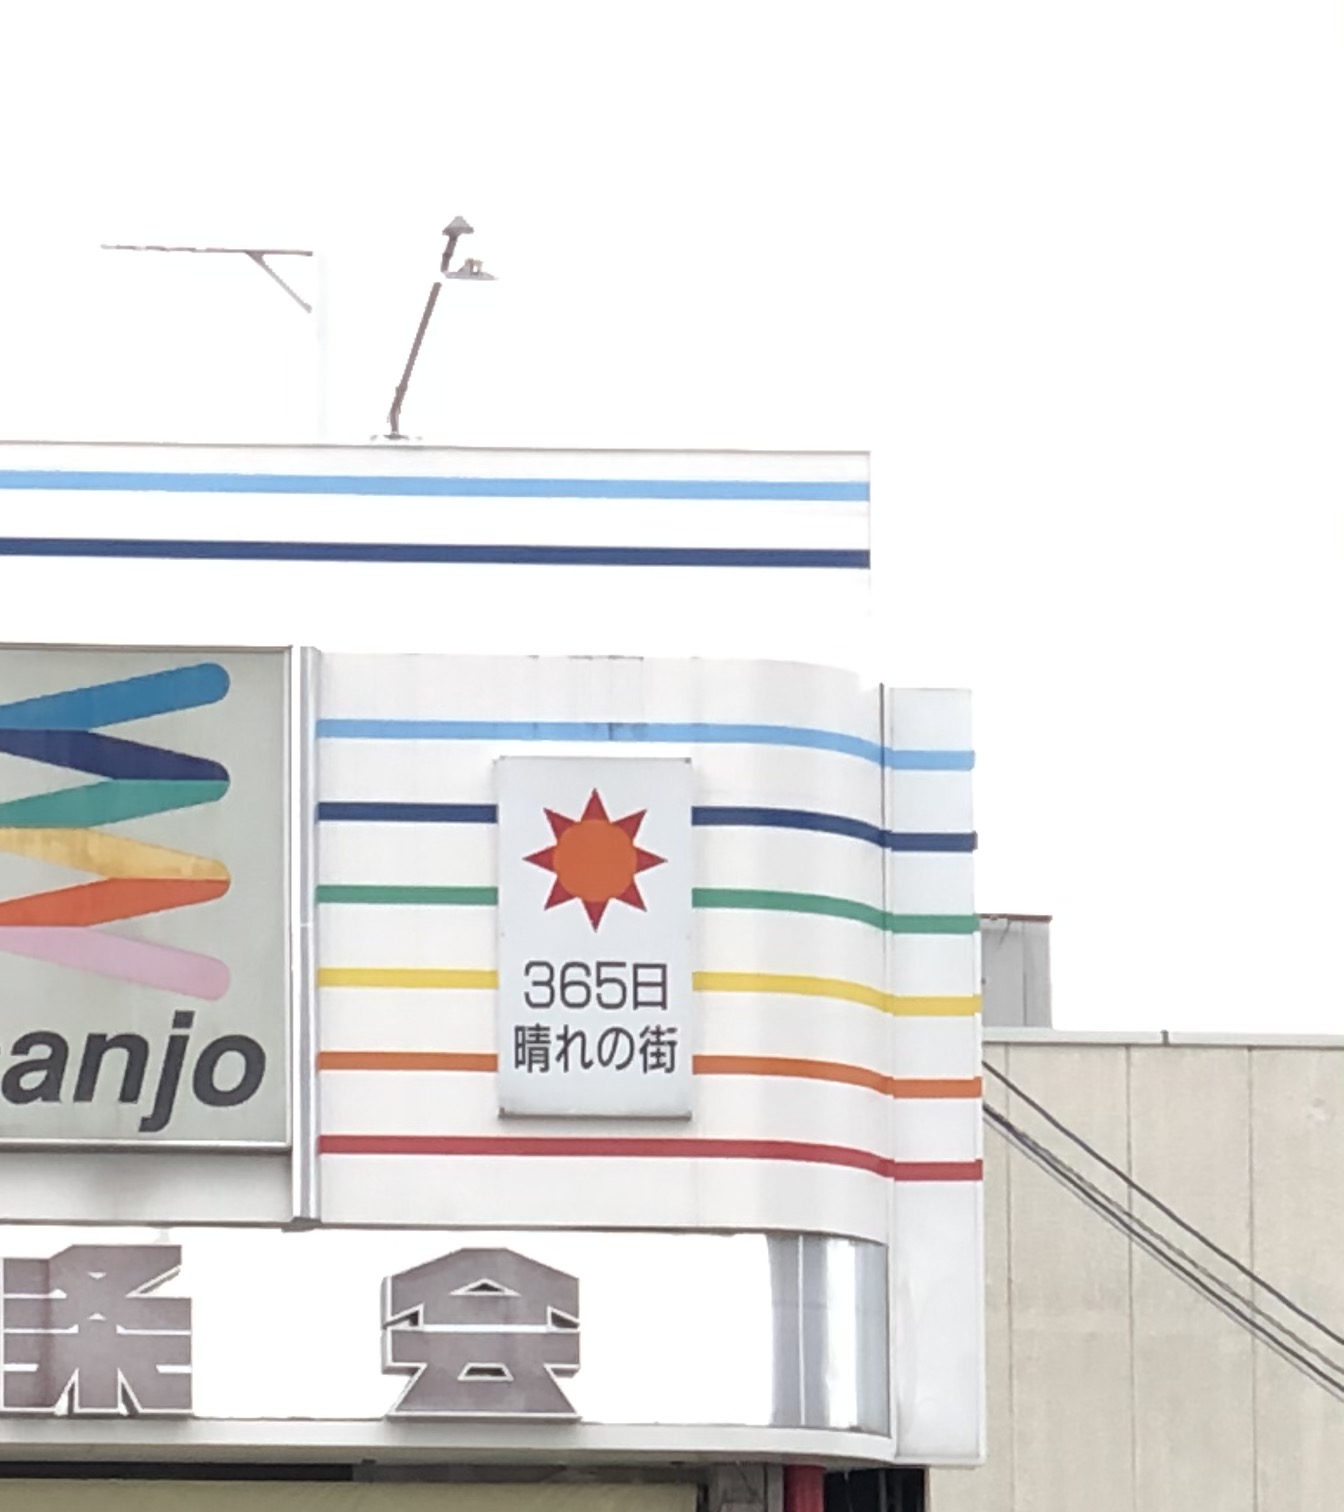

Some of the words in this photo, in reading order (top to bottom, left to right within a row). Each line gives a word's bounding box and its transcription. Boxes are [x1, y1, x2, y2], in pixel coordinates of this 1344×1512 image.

[523, 959, 669, 1011] 365日
[513, 1022, 679, 1075] 晴れの街
